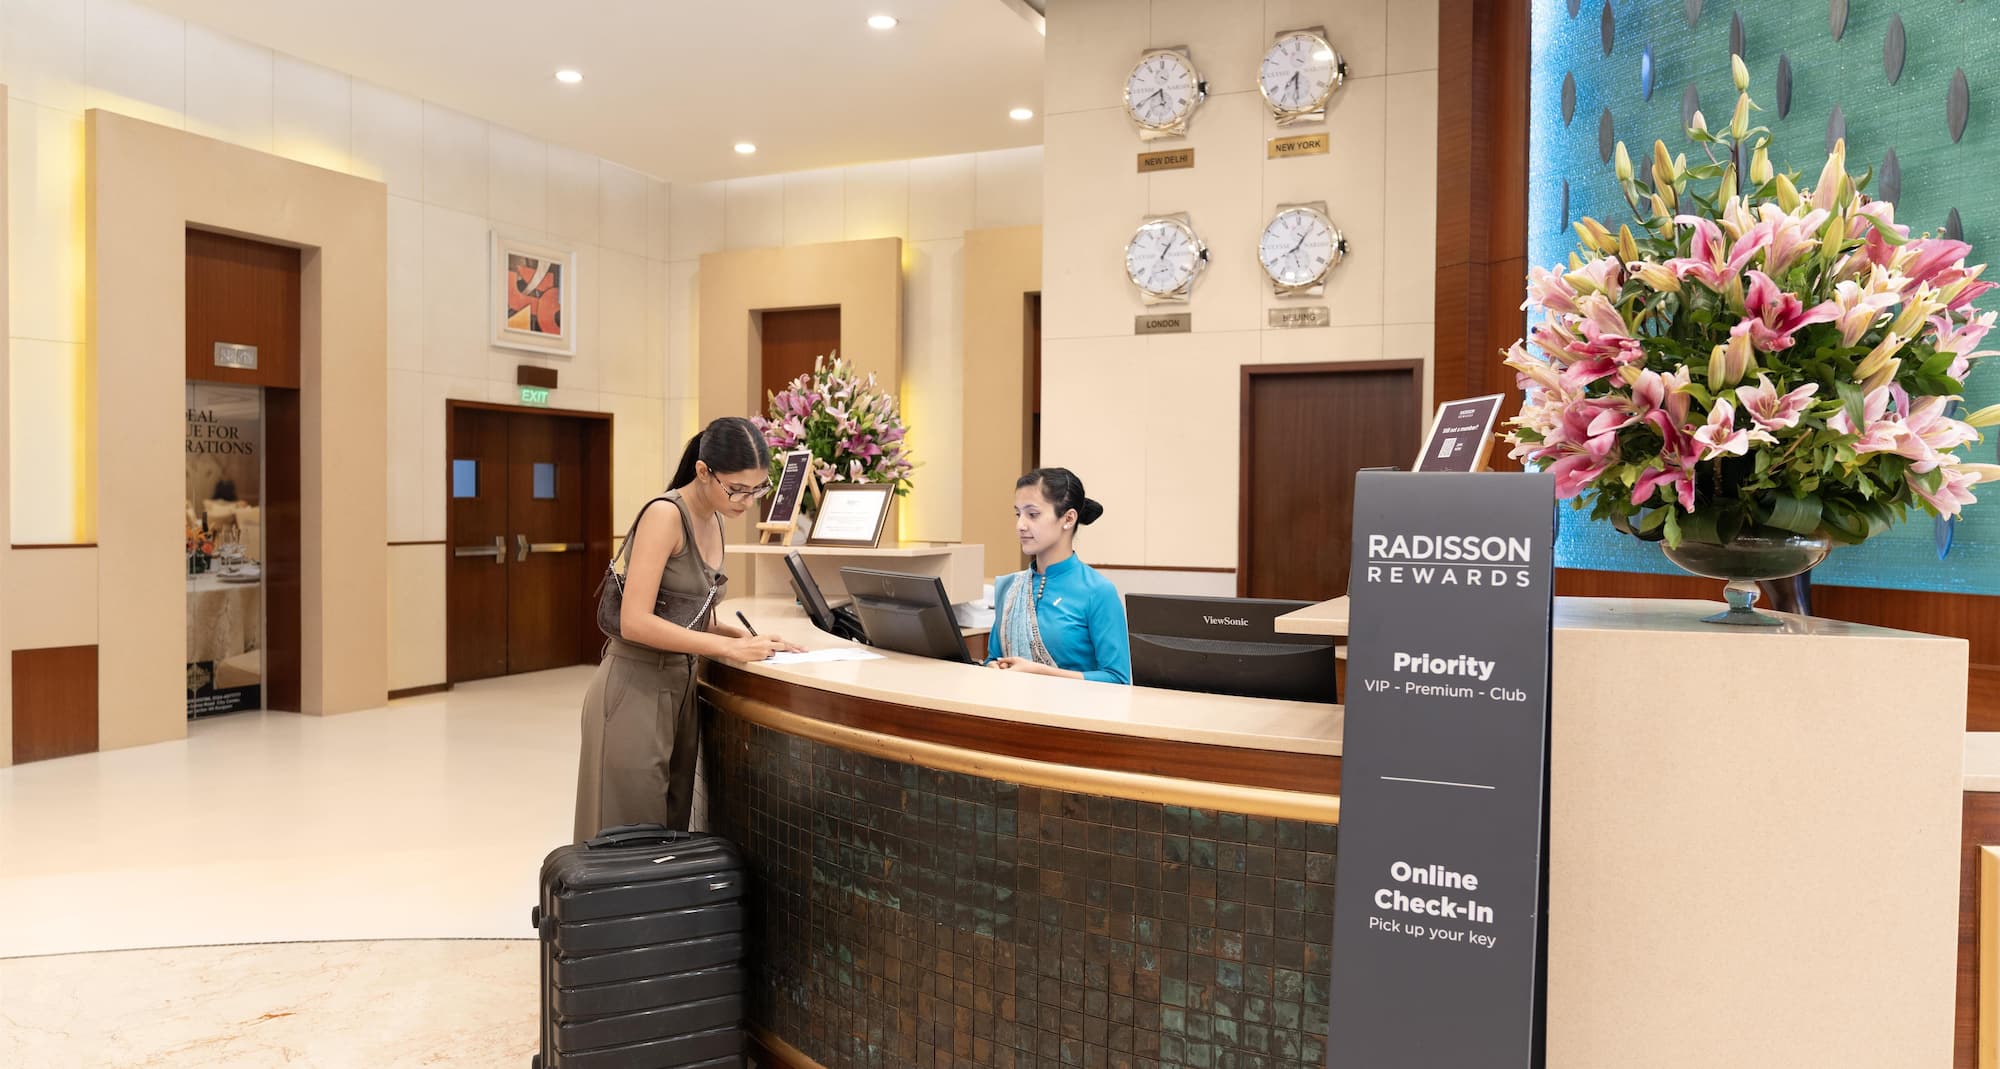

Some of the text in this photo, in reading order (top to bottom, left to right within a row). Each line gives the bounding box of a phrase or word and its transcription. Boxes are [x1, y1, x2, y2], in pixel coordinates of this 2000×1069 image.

[1276, 140, 1321, 152] NEW YORK
[1144, 154, 1188, 166] NEW DELHI
[1146, 319, 1180, 329] LONDON
[522, 389, 548, 404] EXIT
[186, 408, 218, 423] EAL
[208, 425, 240, 439] FOR
[1368, 534, 1531, 562] RADISSON
[1367, 566, 1530, 588] REWARDS
[1202, 615, 1249, 627] ViewSonic
[1393, 652, 1496, 681] Priority
[1364, 679, 1391, 693] VIP
[1405, 681, 1474, 698] Premium
[1490, 687, 1527, 702] Club
[1390, 861, 1479, 891] Online
[1374, 888, 1494, 924] Check-In
[1369, 916, 1497, 949] Pick up your key
